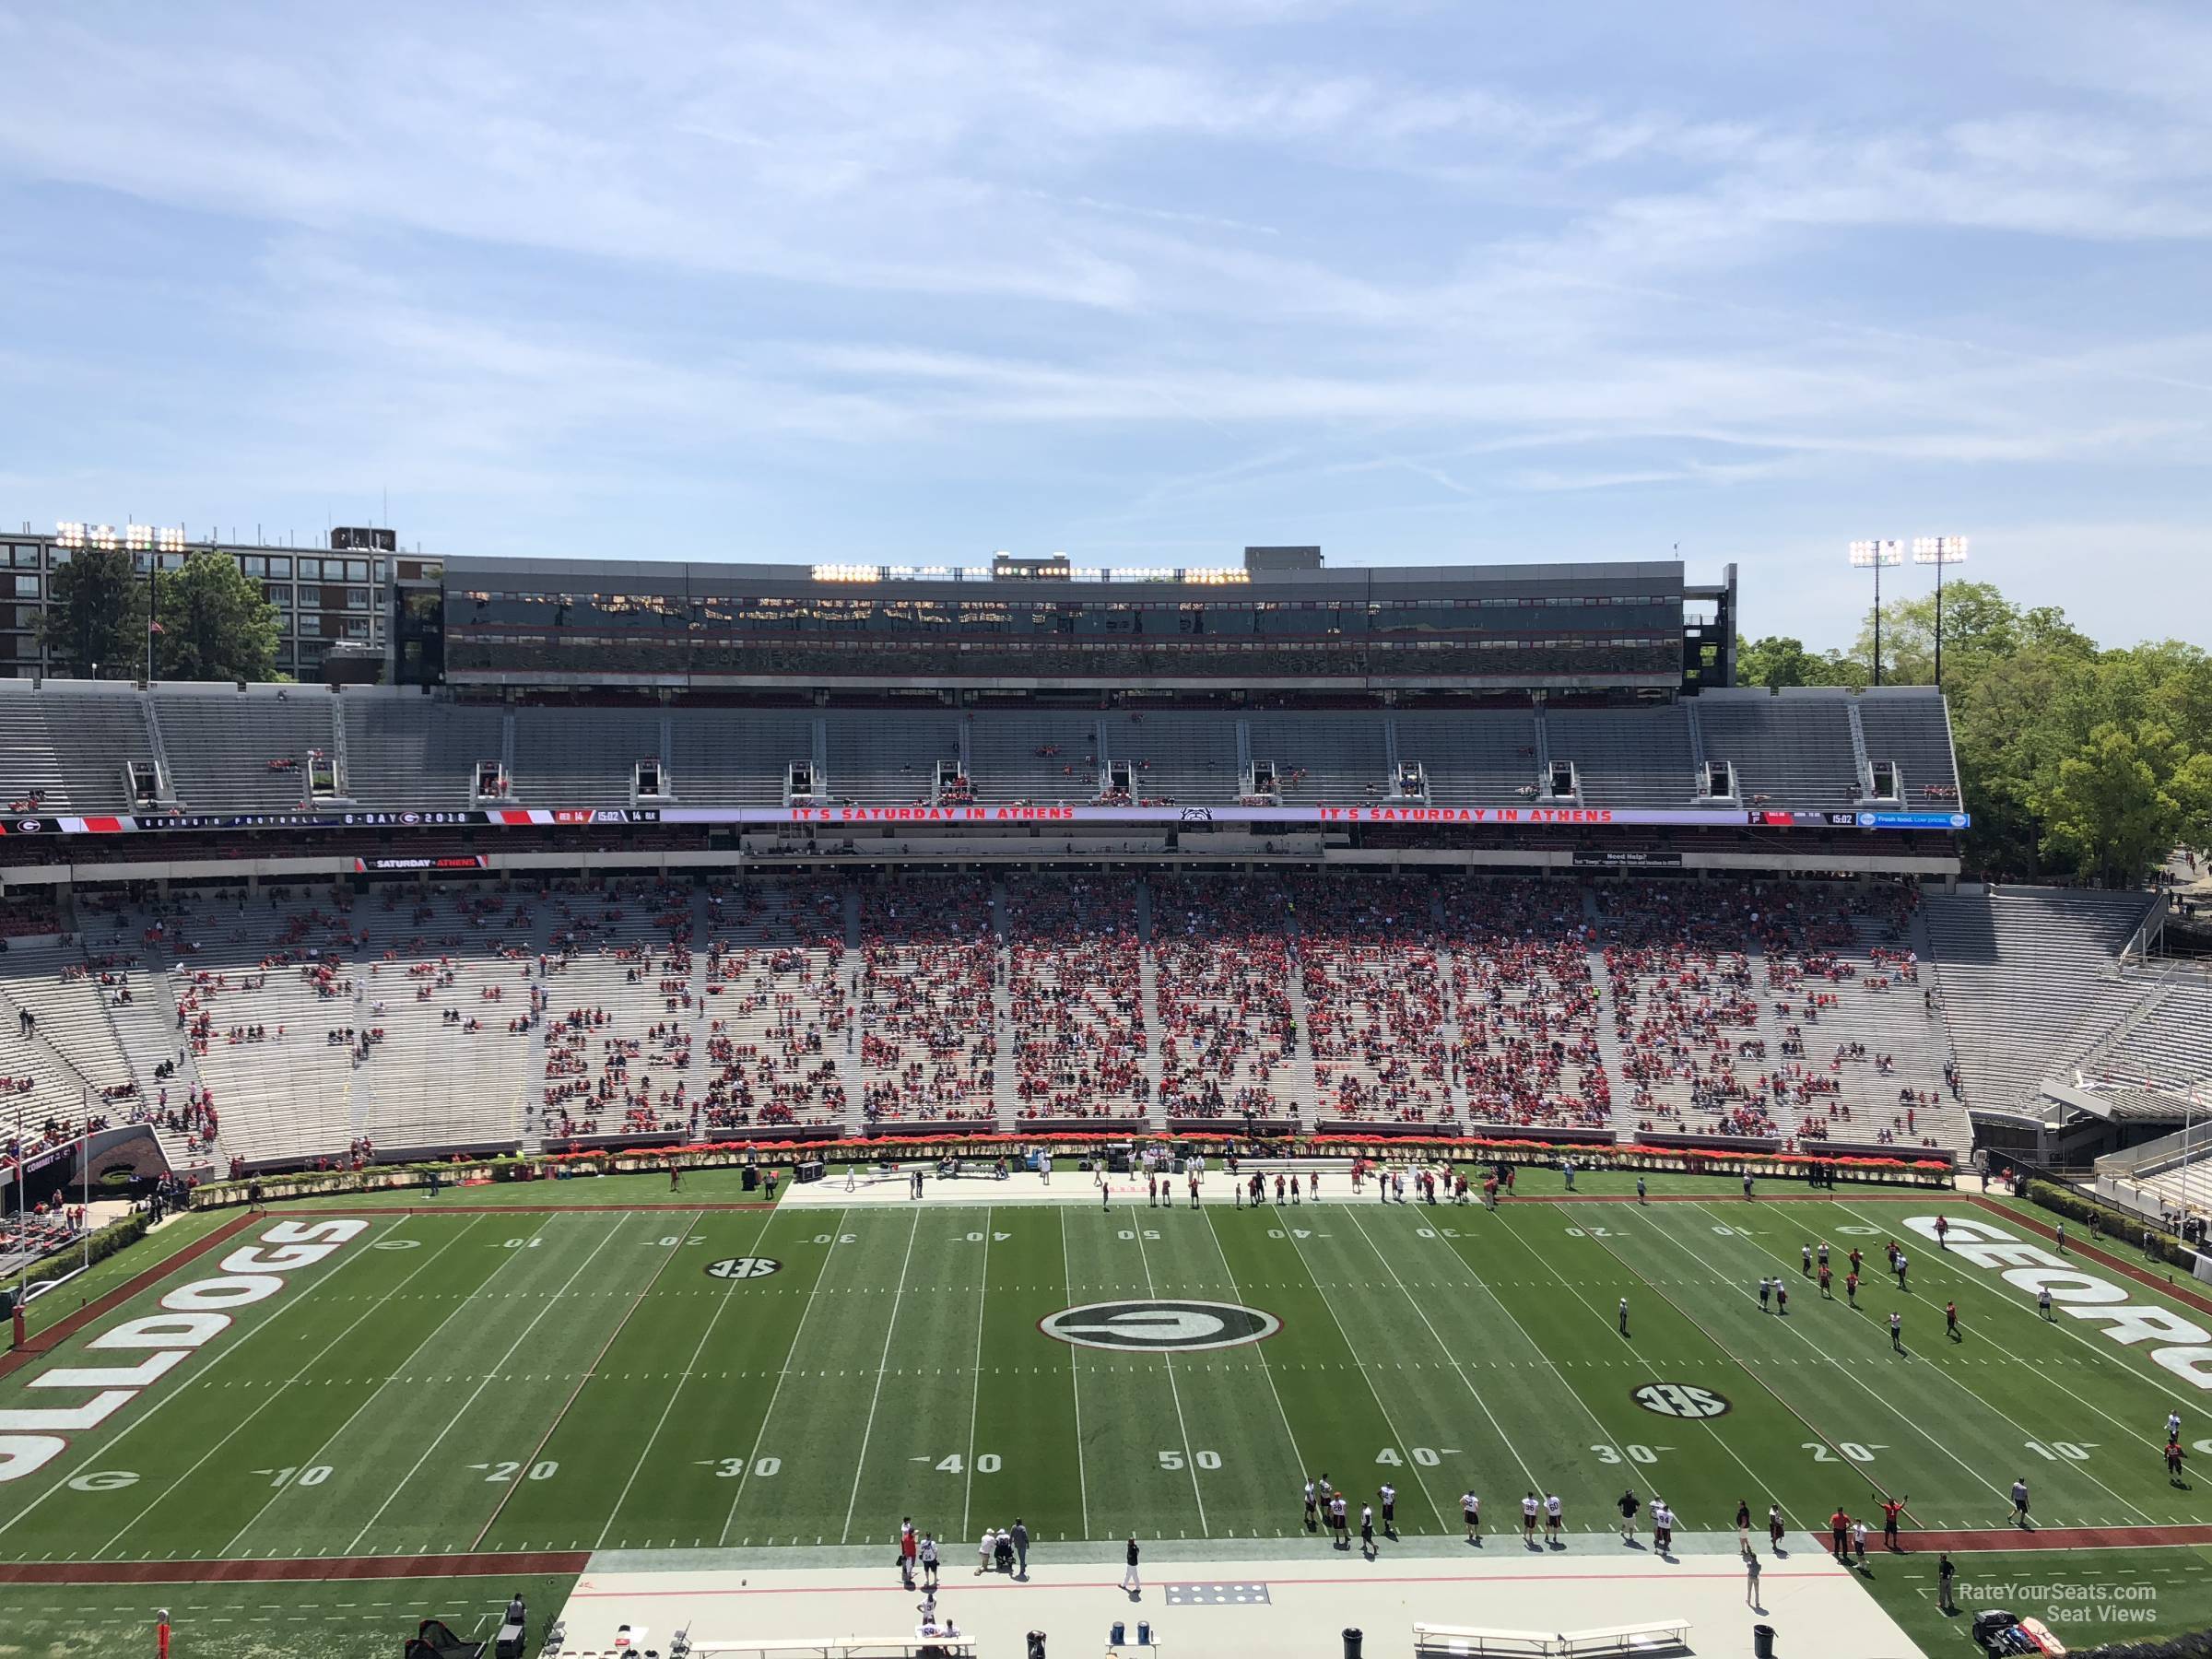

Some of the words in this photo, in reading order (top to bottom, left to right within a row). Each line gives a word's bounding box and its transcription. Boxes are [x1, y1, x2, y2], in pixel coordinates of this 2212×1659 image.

[345, 813, 396, 823] G-DAY
[425, 812, 465, 823] 2018
[574, 811, 583, 821] 14
[597, 811, 619, 821] 15:02
[632, 811, 641, 821] 14
[792, 807, 830, 820] IT'S
[841, 807, 955, 819] SATURDAY
[966, 807, 986, 819] IN
[996, 806, 1075, 819] ATHENS
[1321, 807, 1359, 819] IT'S
[1370, 808, 1486, 820] SATURDAY
[1497, 809, 1518, 820] IN
[1530, 809, 1613, 822] ATHENS
[145, 818, 220, 827] GEORGIA
[235, 816, 319, 825] FOOTBALL
[1832, 815, 1853, 824] 15:02
[376, 859, 431, 868] SATURDAY
[436, 858, 477, 867] ATHENS
[27, 1155, 54, 1173] COMMIT
[966, 1231, 1012, 1241] 40
[1117, 1230, 1161, 1241] 50
[1266, 1229, 1312, 1240] 40
[1415, 1228, 1462, 1239] 30
[1564, 1227, 1612, 1237] 20
[1711, 1226, 1753, 1236] 10
[503, 1238, 544, 1249] 10
[658, 1235, 707, 1246] 20
[813, 1233, 857, 1244] 30
[708, 1257, 779, 1279] SEC
[1053, 1301, 1268, 1348] G
[1635, 1383, 1726, 1418] SEC
[1374, 1446, 1441, 1466] 40
[1589, 1444, 1658, 1464] 30
[1800, 1441, 1877, 1463] 20
[2023, 1441, 2090, 1461] 10
[935, 1453, 1003, 1475] 40
[1158, 1450, 1223, 1471] 50
[484, 1460, 560, 1482] 20
[714, 1456, 782, 1477] 30
[67, 1470, 141, 1491] G
[269, 1465, 335, 1488] 10
